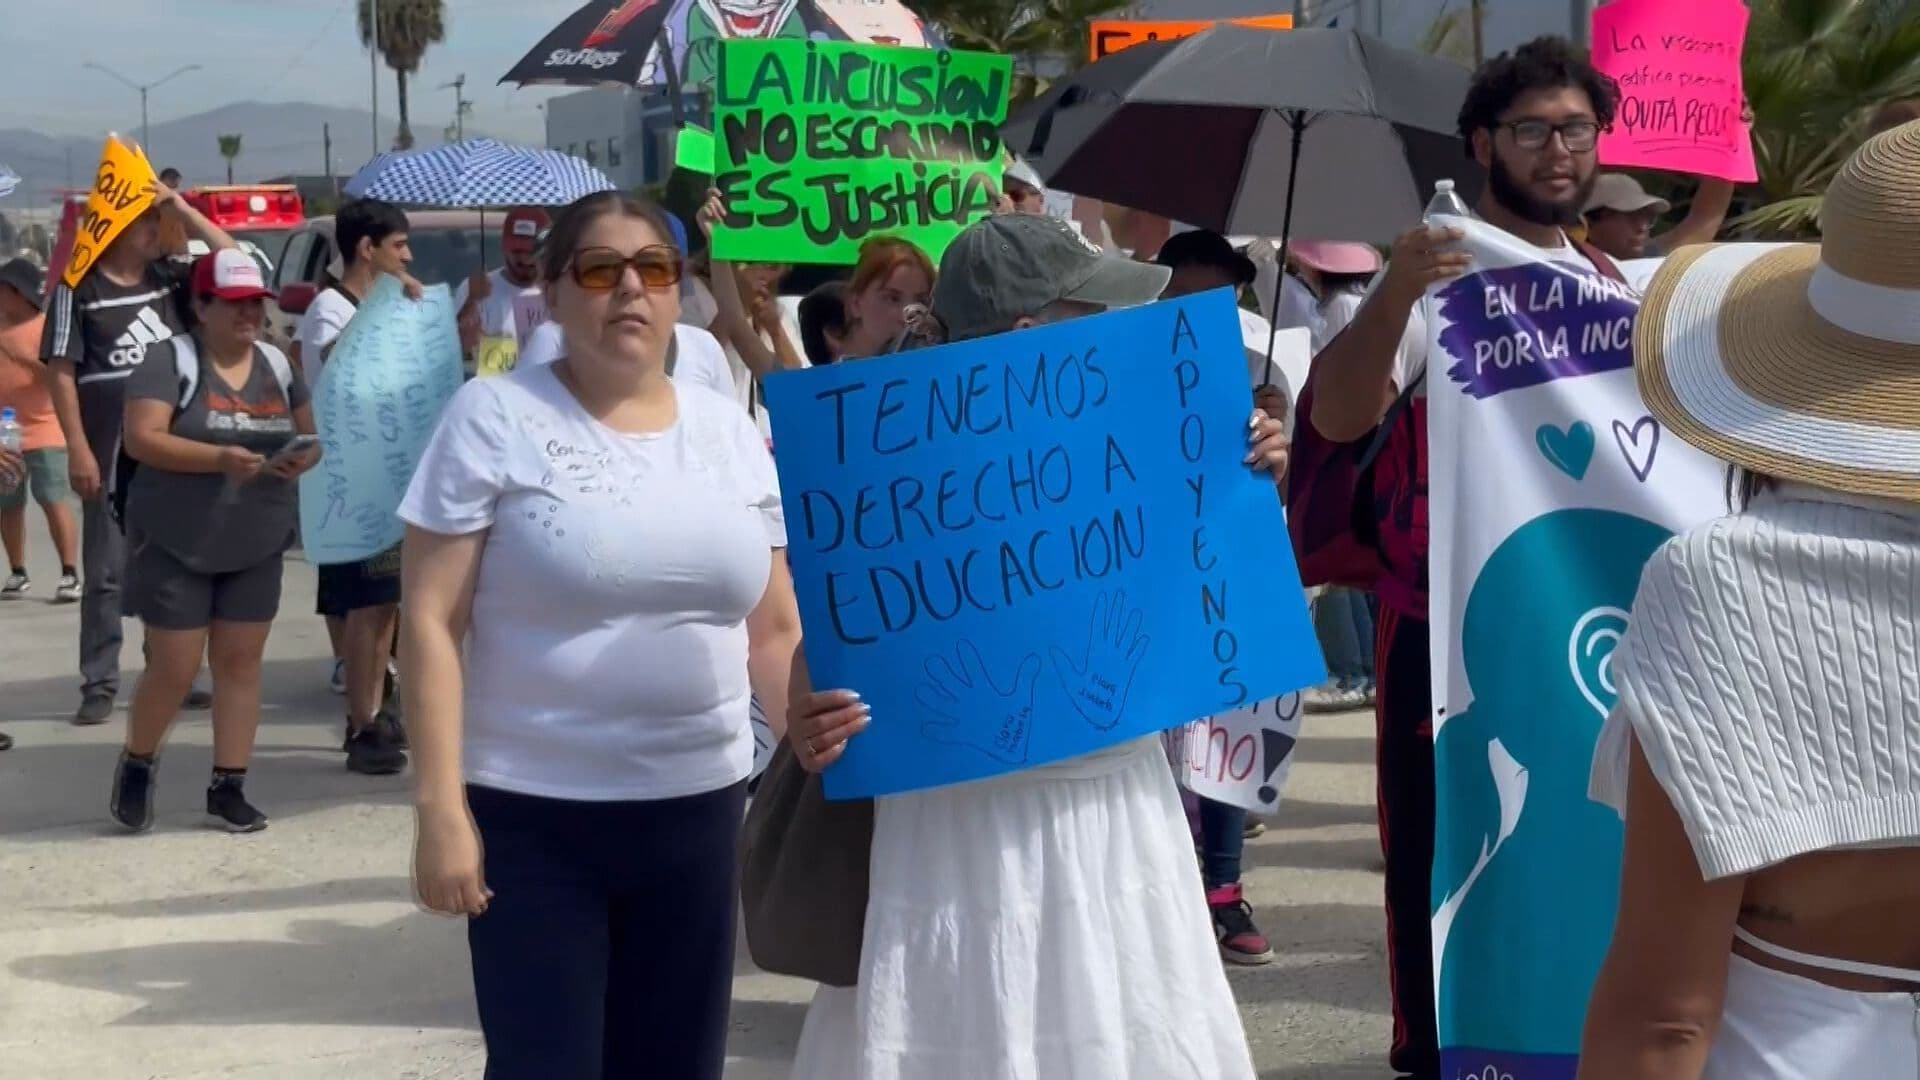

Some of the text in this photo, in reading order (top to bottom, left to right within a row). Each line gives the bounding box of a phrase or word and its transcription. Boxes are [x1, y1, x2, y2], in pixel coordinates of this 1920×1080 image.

[1611, 26, 1646, 53] La
[717, 40, 793, 106] LA
[723, 108, 798, 168] NO
[1622, 96, 1679, 136] QUITA
[716, 170, 799, 229] ES
[1485, 283, 1517, 320] EN
[1529, 277, 1565, 312] LA
[1473, 317, 1635, 375] POR LA INC
[816, 347, 1109, 464] TENEMOS
[800, 434, 1136, 554] DERECHO A
[826, 505, 1144, 646] EDUCACION
